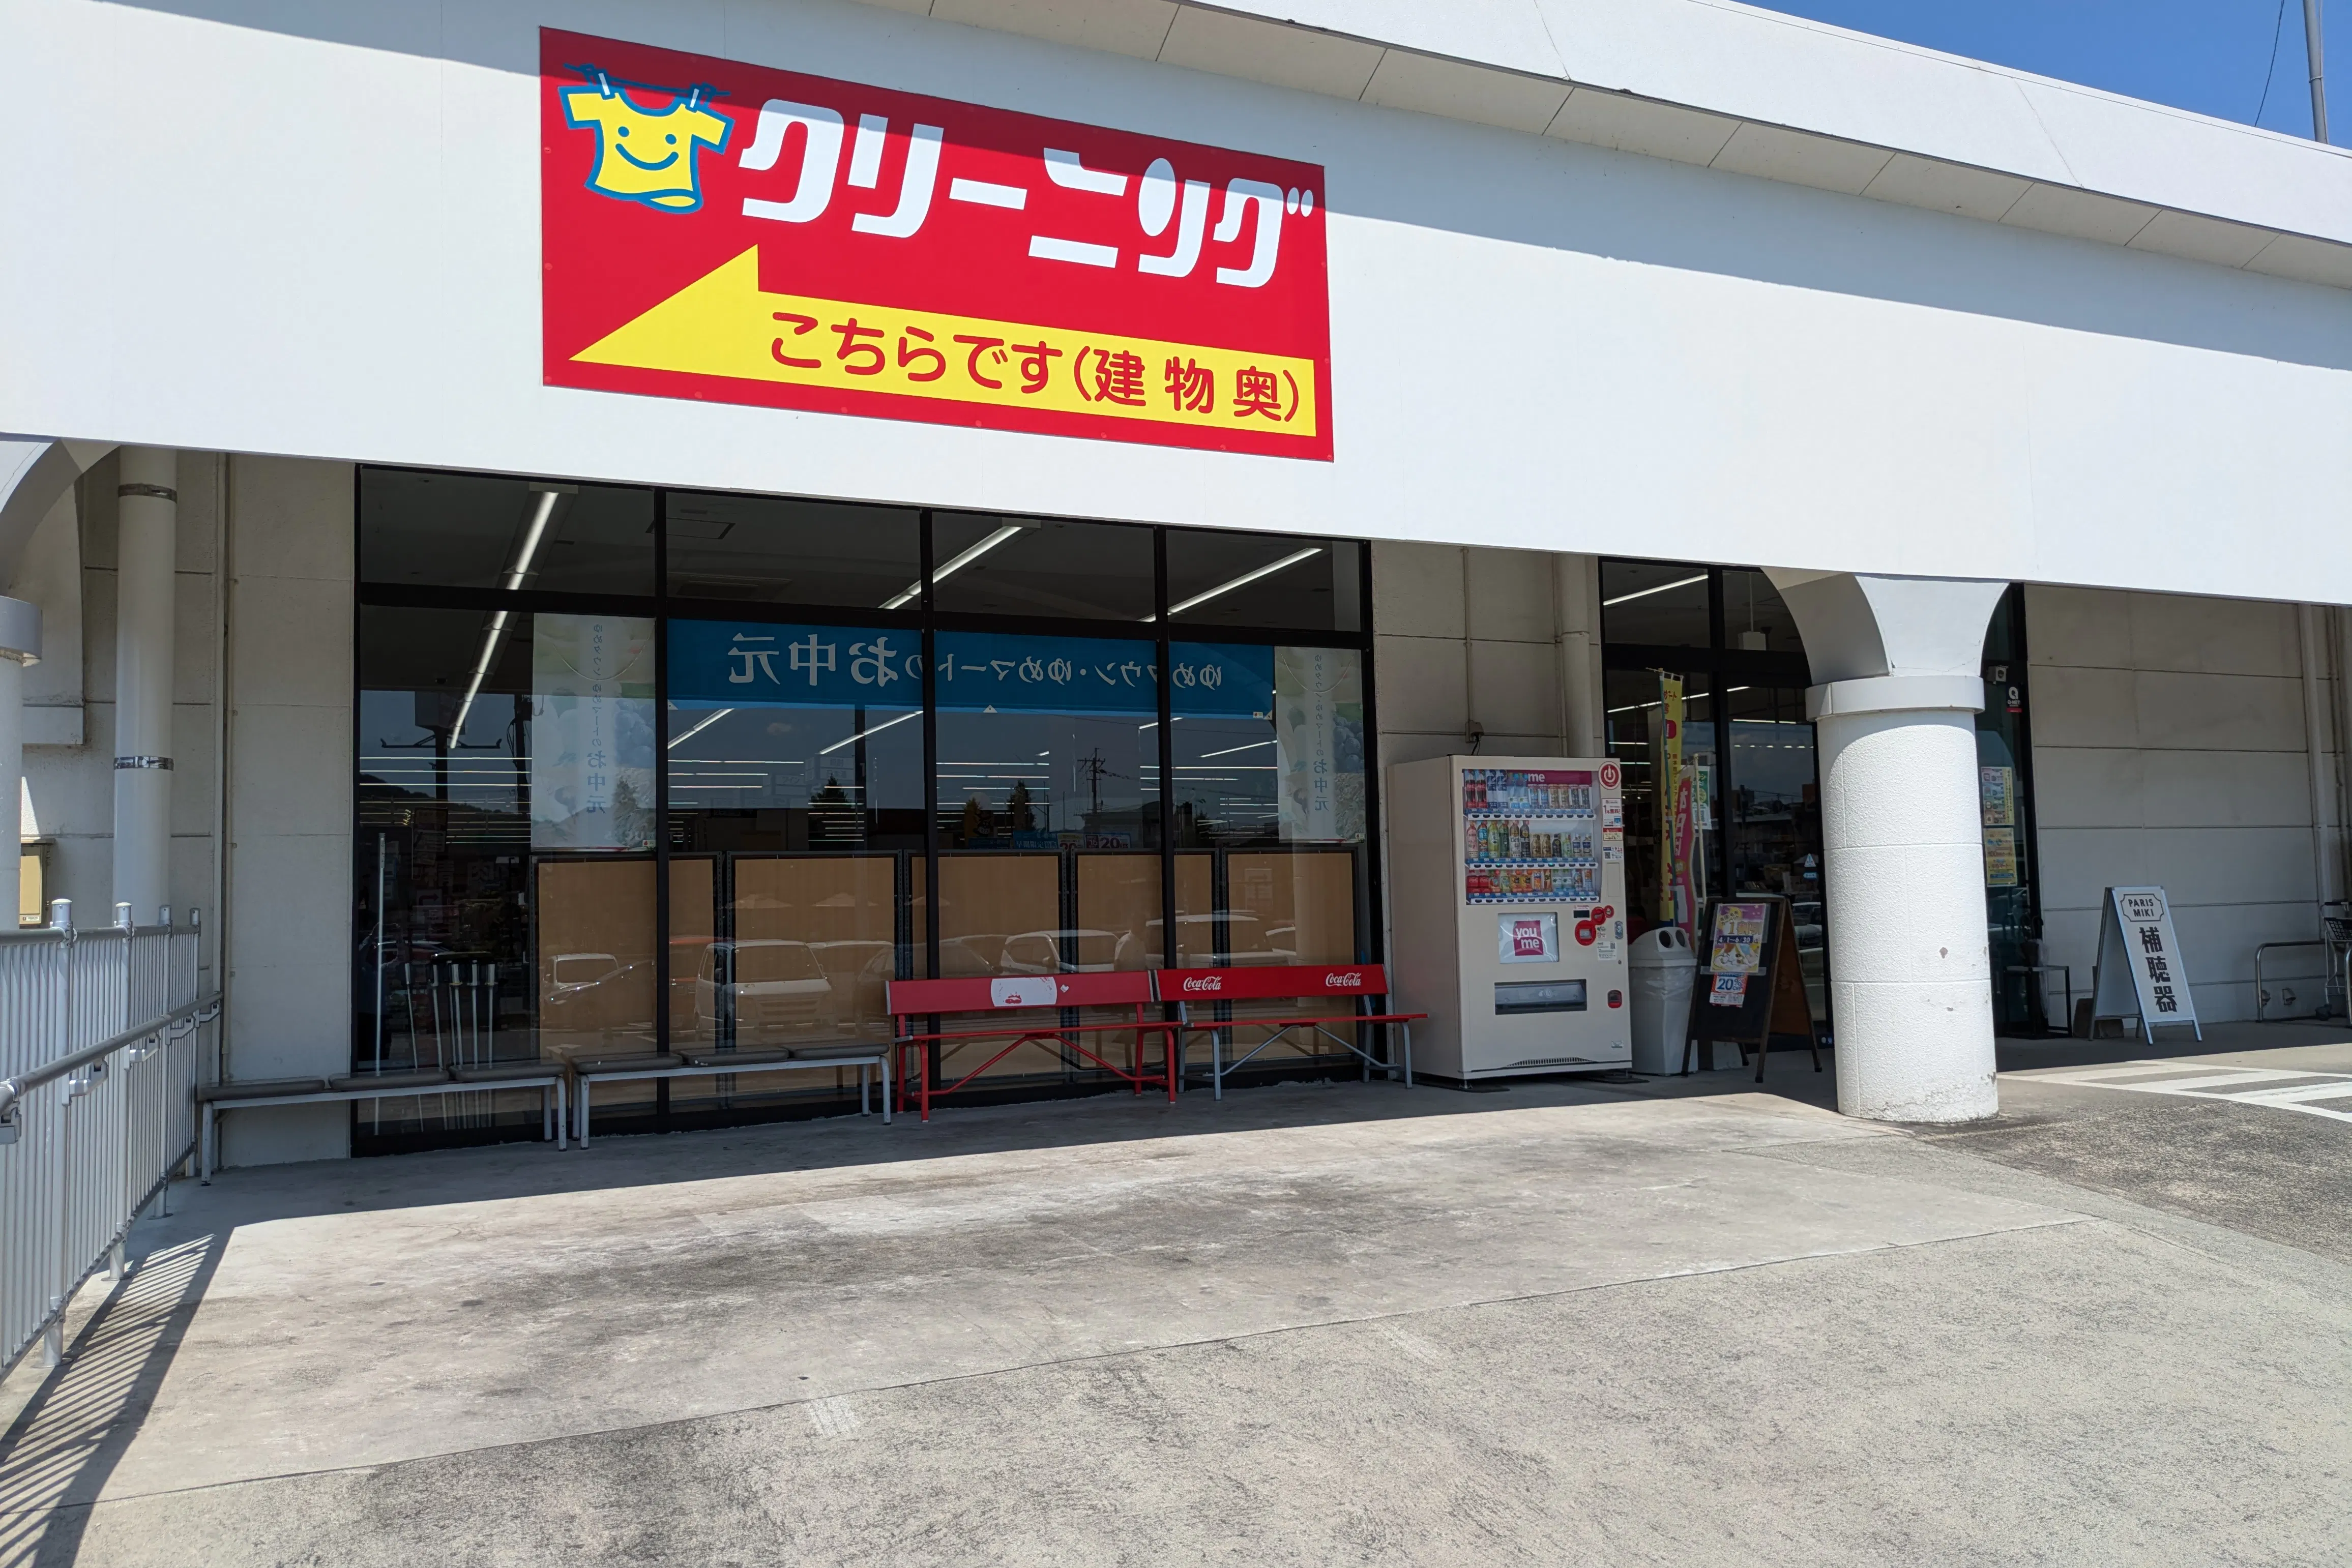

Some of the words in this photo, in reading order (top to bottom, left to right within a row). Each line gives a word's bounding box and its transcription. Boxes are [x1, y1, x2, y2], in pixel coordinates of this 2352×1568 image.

[738, 97, 1315, 289] クリーニング
[770, 310, 1300, 423] こちらです（建物奥）
[2128, 899, 2155, 908] PARIS
[2133, 908, 2155, 918] MIKI
[1515, 927, 1537, 940] you
[1520, 939, 1540, 949] me
[2138, 926, 2178, 1014] 補聴器
[1183, 975, 1222, 992] Coca-Cola
[1326, 972, 1362, 987] Coca-Cola
